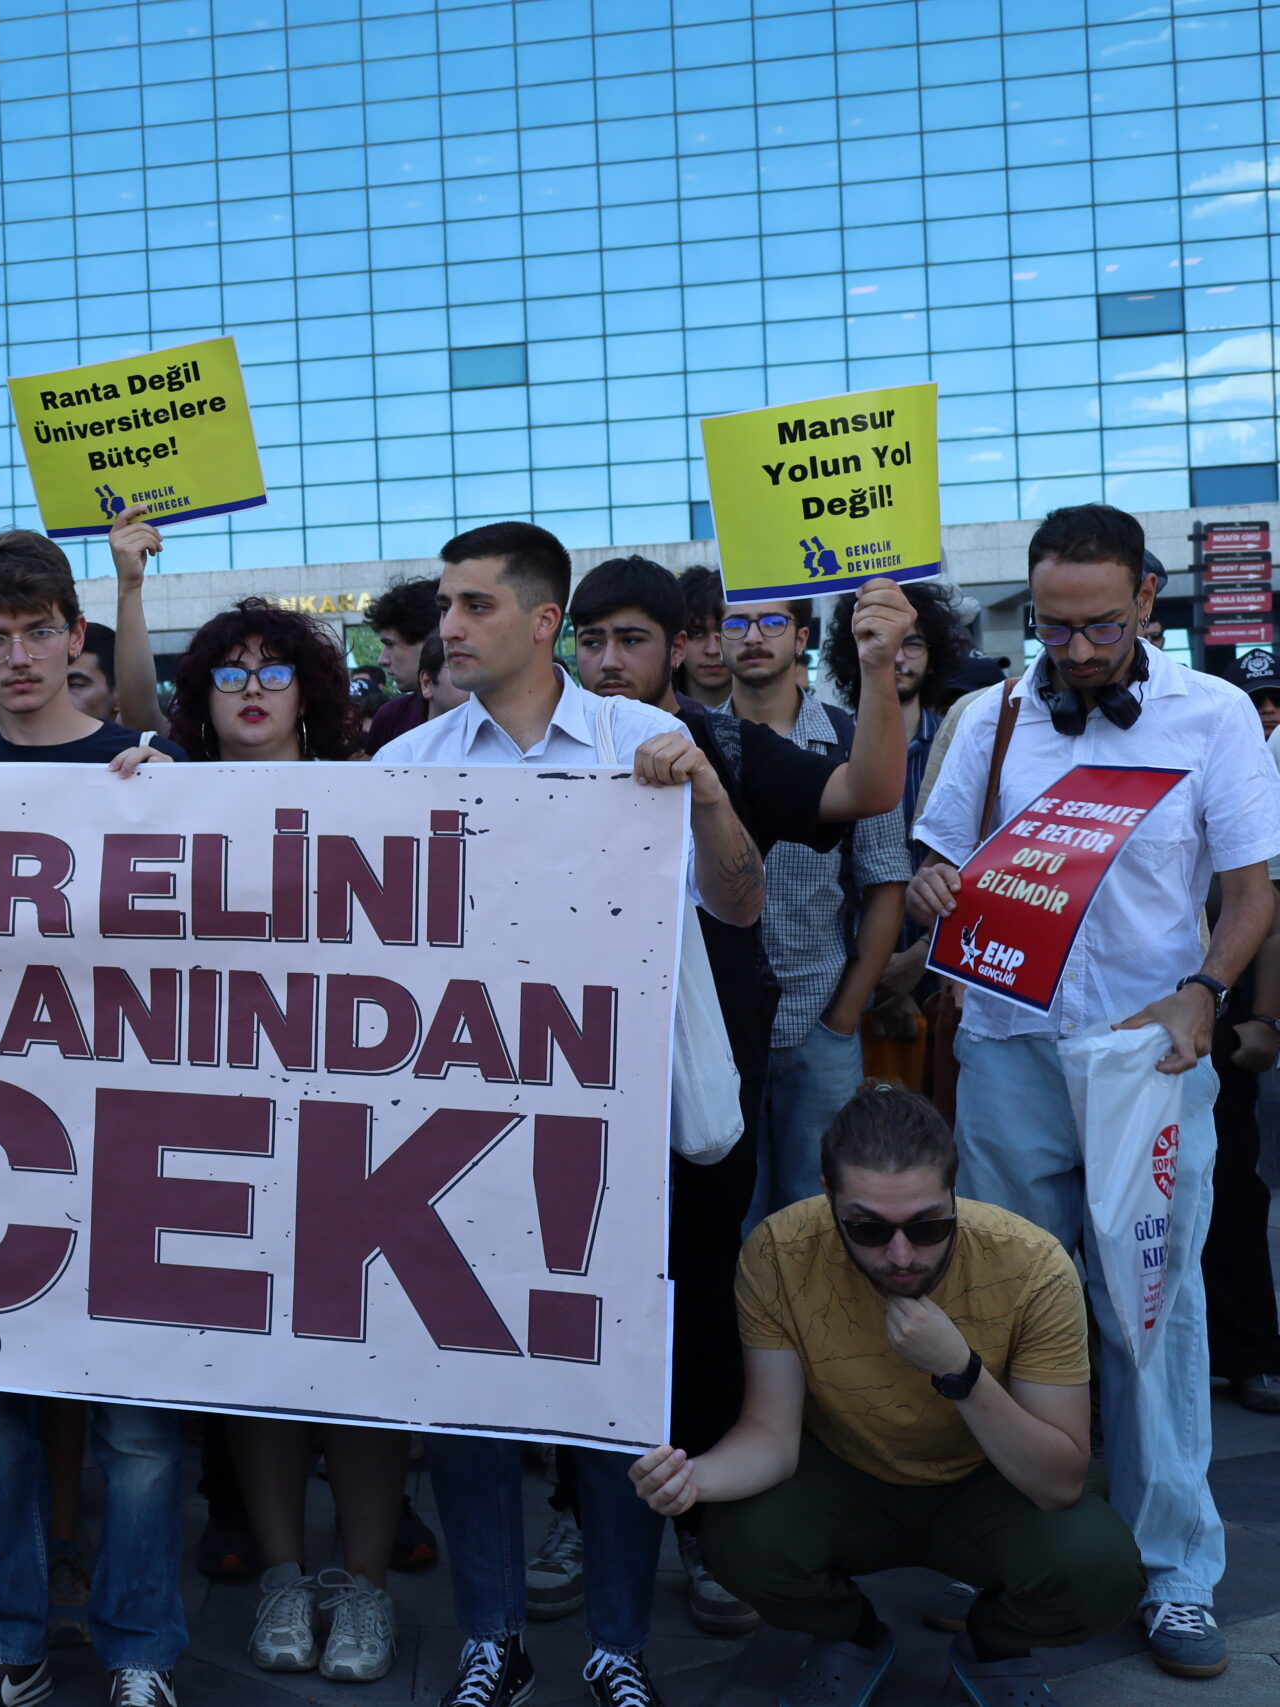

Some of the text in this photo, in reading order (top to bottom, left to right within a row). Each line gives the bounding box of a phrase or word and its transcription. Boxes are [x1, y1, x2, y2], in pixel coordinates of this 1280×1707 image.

[40, 361, 201, 411] Ranta Değil
[34, 395, 226, 444] Üniversitelere
[777, 410, 895, 445] Mansur
[88, 436, 179, 471] Bütçe!
[762, 441, 911, 486] Yolun Yol
[131, 485, 175, 502] GENÇLİK
[142, 496, 191, 515] VİRECEK
[801, 485, 893, 520] Değil!
[845, 540, 892, 557] GENÇLİK
[847, 554, 901, 573] DEVİRECEK
[1027, 797, 1148, 827] NE SERMAYE
[1009, 820, 1116, 854] NE REKTÖR
[99, 808, 467, 948] ELİNİ
[1011, 847, 1067, 875] ODTÜ
[976, 869, 1070, 914] BİZİMDİR
[982, 940, 1025, 971] EHP
